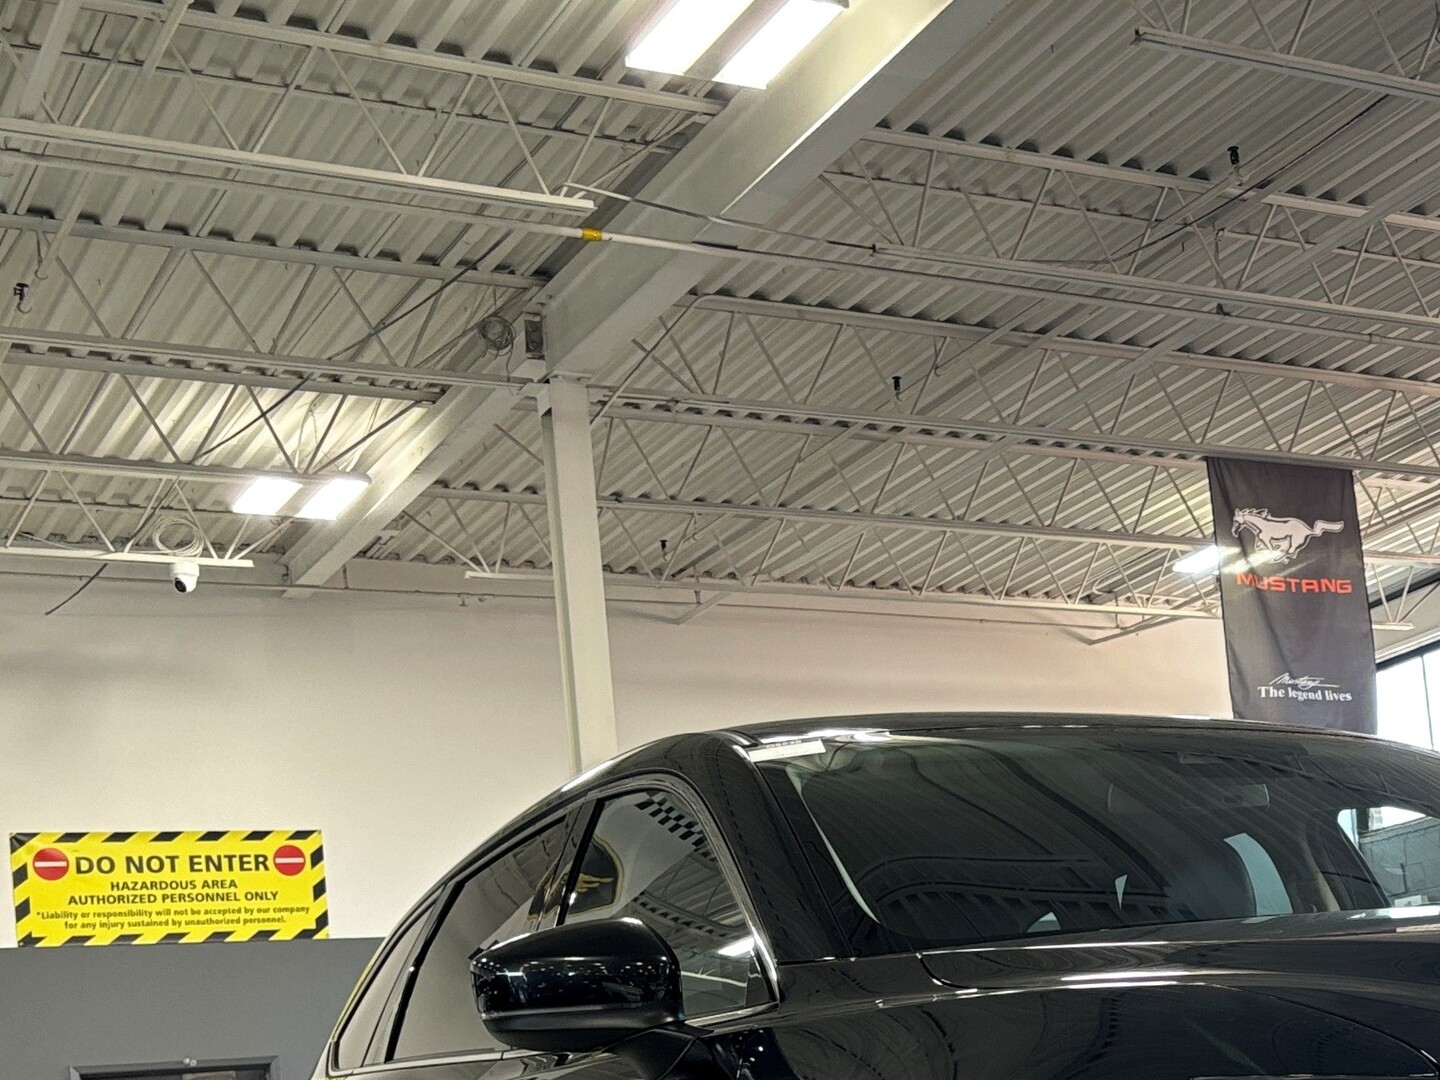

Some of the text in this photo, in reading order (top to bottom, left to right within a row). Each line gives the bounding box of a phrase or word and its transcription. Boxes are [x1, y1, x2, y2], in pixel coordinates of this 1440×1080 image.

[1236, 571, 1352, 594] MUSTANG
[1257, 685, 1353, 702] The legend lives
[75, 853, 271, 875] DO NOT ENTER
[110, 879, 238, 892] HAZARDOUS AREA
[67, 890, 279, 906] AUTHORIZED PERSONNEL ONLY
[80, 911, 90, 919] or
[93, 909, 153, 921] responsibility
[155, 908, 171, 916] will
[173, 908, 189, 916] not
[190, 907, 201, 916] be
[203, 907, 242, 917] accepted
[244, 906, 254, 916] by
[273, 906, 310, 915] company
[64, 921, 78, 930] for
[80, 922, 97, 931] any
[99, 920, 125, 930] injury
[127, 919, 169, 928] sustained
[171, 918, 182, 928] by
[184, 917, 241, 926] unauthorized
